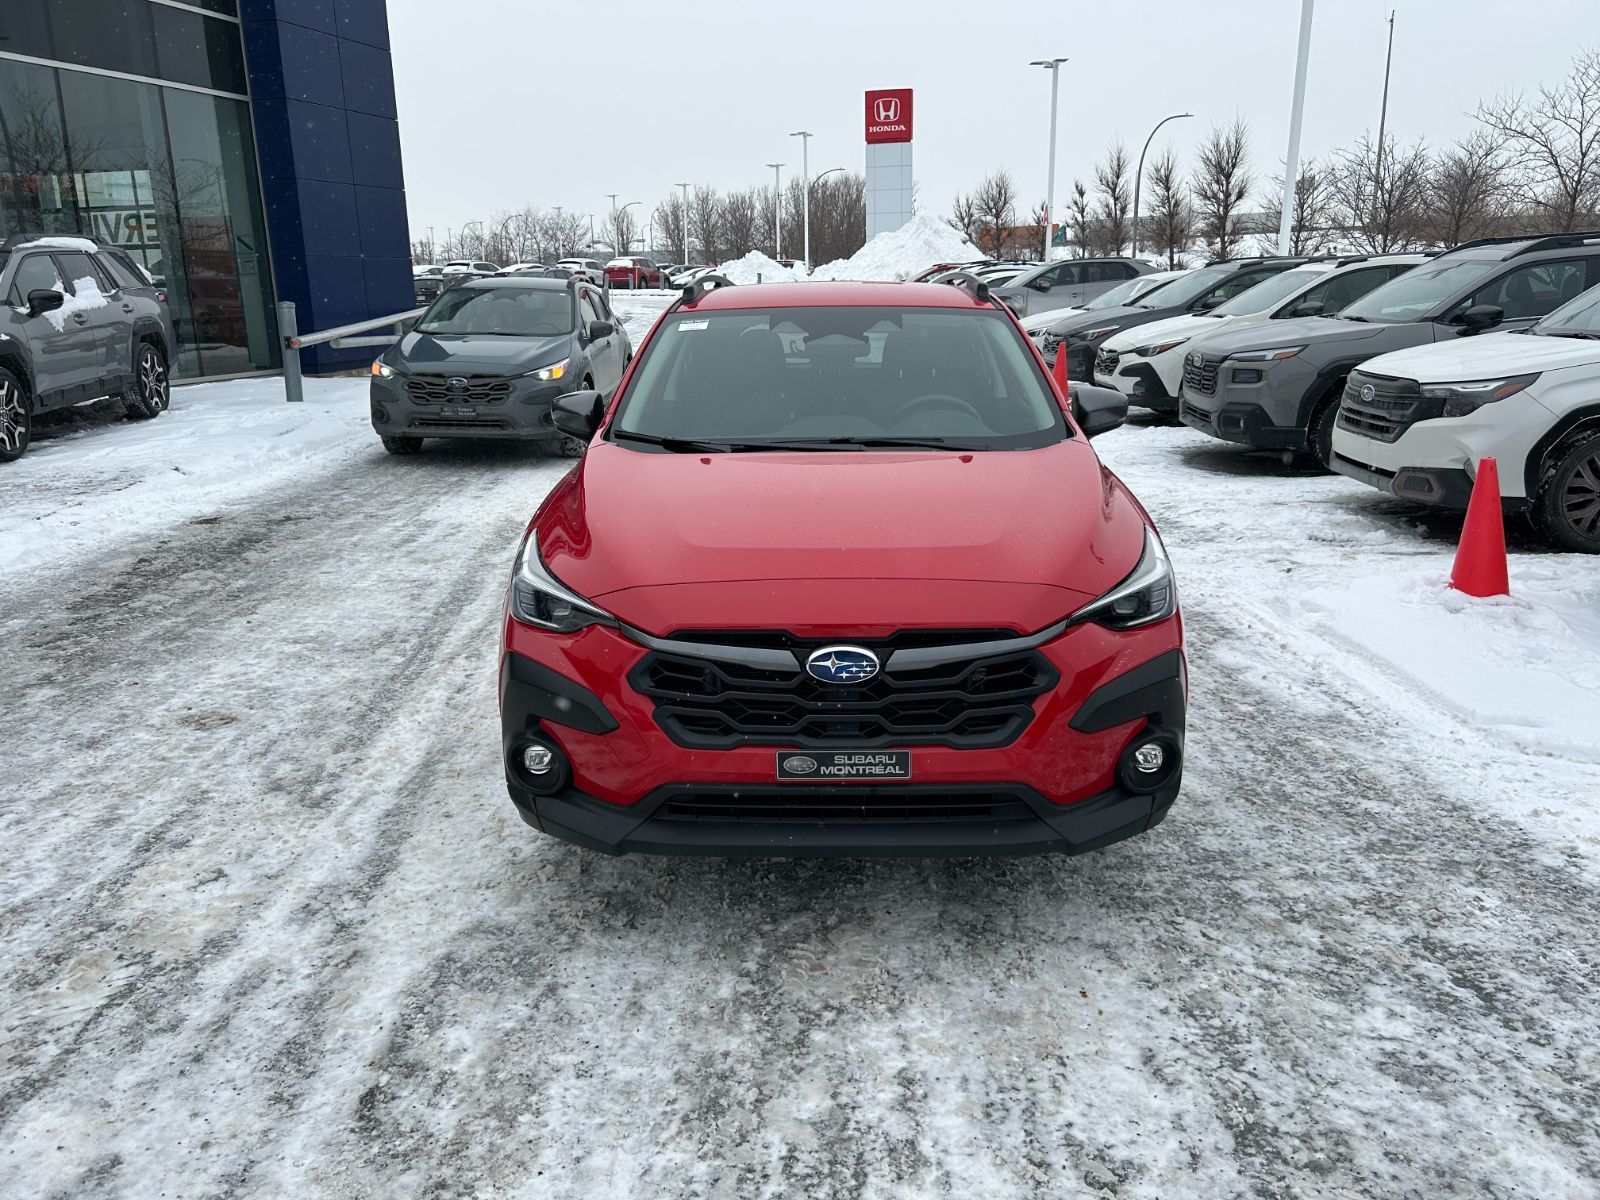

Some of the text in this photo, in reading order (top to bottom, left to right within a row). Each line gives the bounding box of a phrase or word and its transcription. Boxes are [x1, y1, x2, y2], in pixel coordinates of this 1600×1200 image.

[868, 125, 906, 133] HONDA
[834, 755, 896, 764] SUBARU
[820, 764, 905, 775] MONTRÉAL
